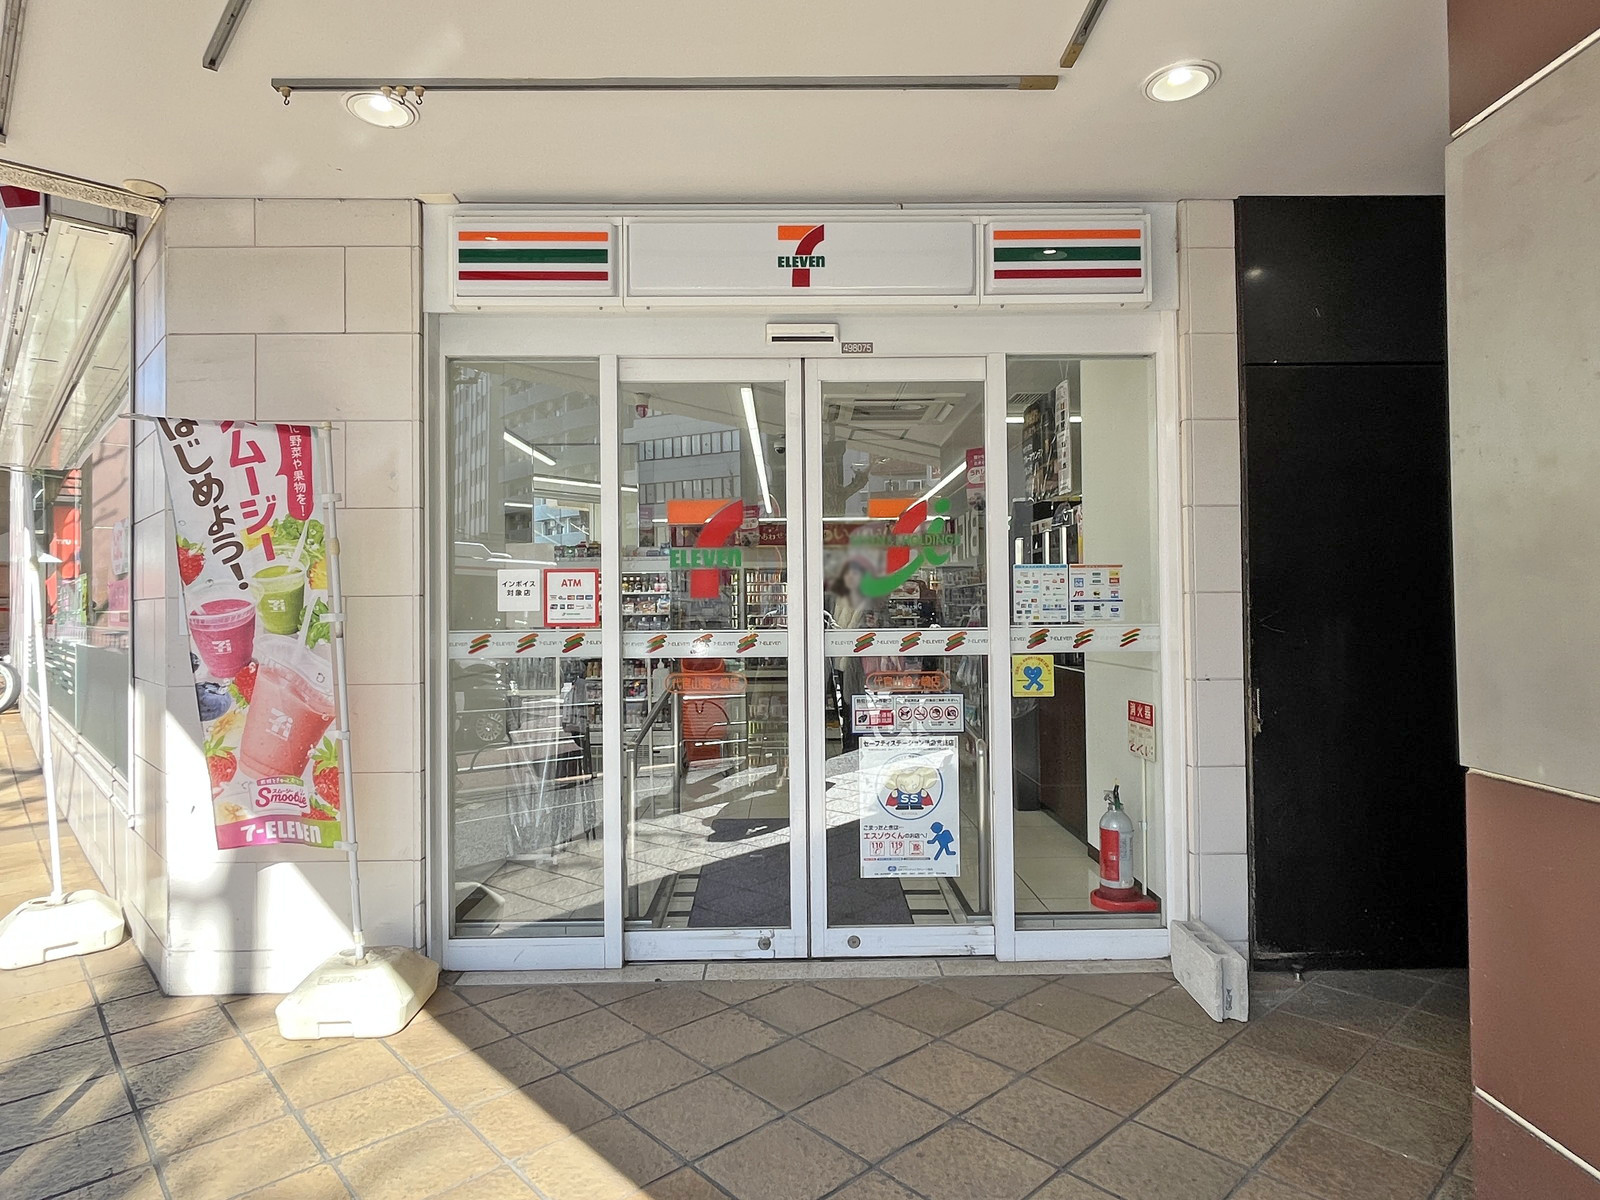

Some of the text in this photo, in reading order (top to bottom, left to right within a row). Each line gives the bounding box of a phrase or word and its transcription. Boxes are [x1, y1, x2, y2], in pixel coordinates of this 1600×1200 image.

[843, 344, 872, 353] 498075
[561, 579, 582, 587] ATM
[506, 589, 531, 597] 対象店
[900, 794, 918, 803] SS
